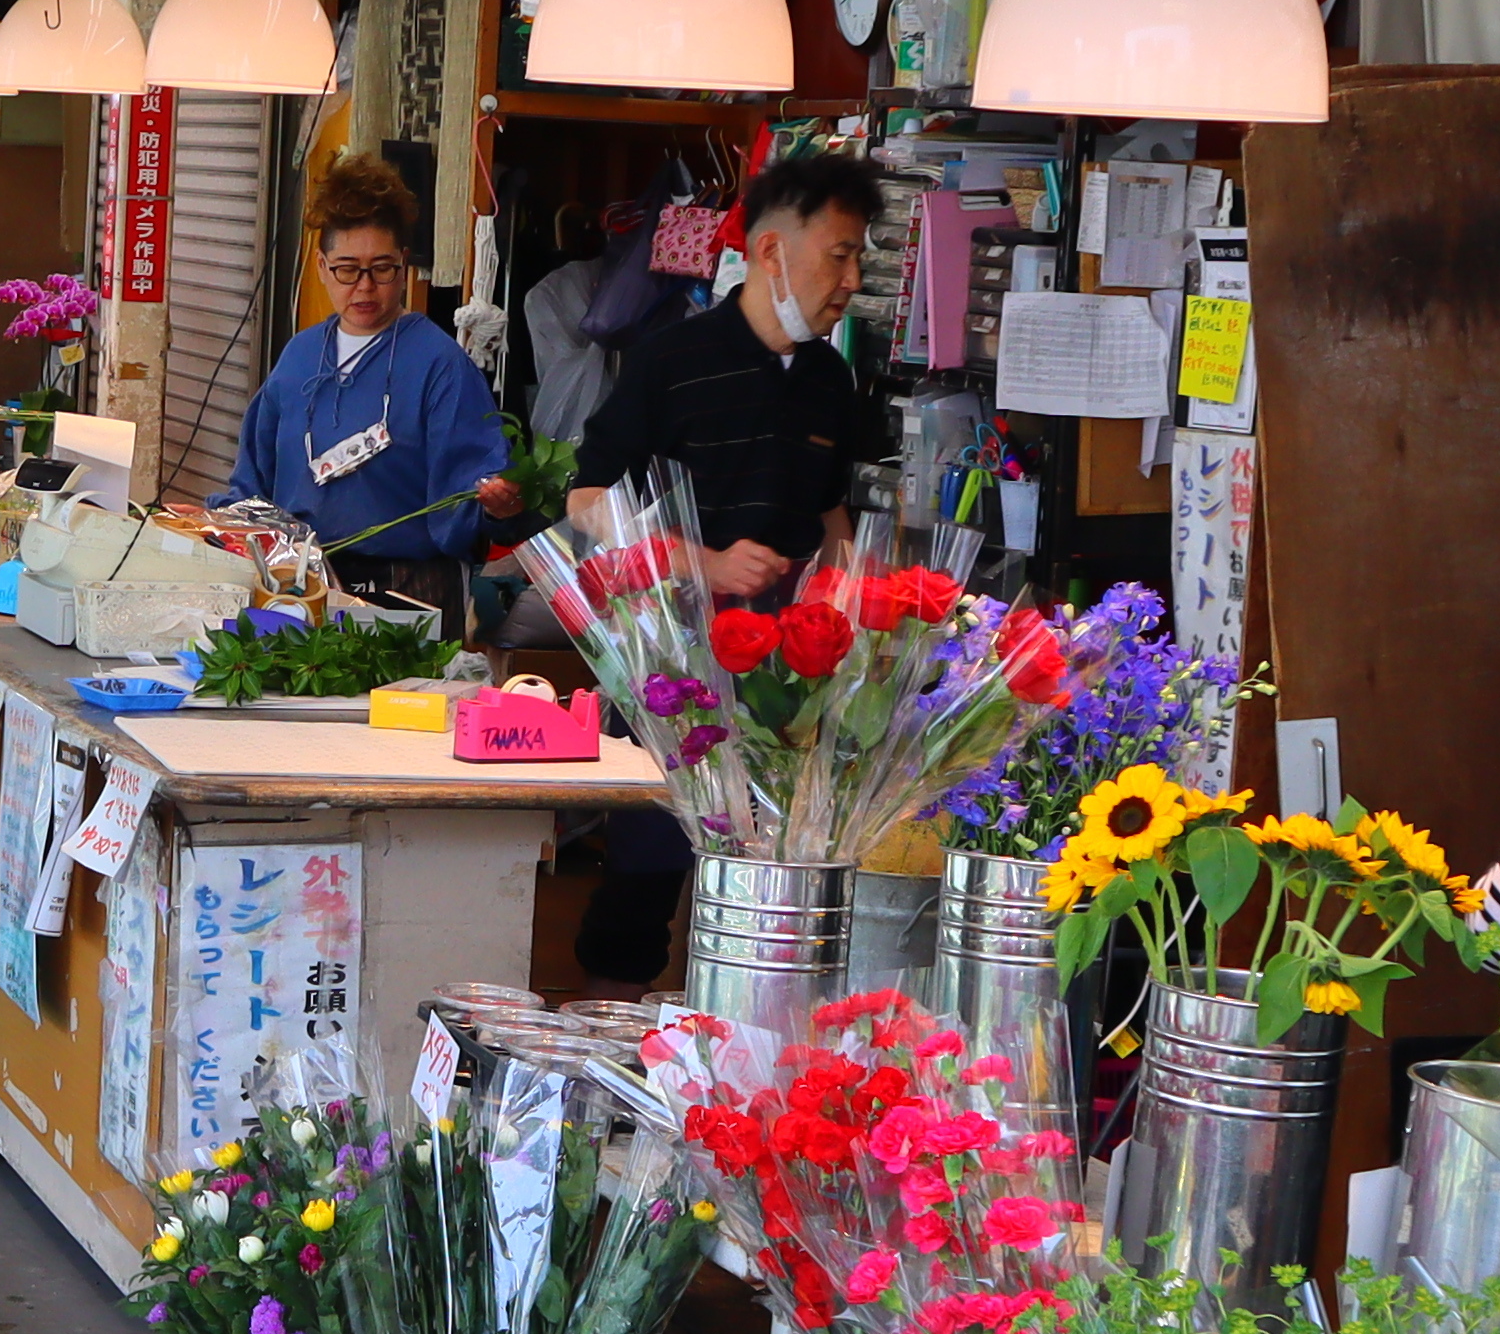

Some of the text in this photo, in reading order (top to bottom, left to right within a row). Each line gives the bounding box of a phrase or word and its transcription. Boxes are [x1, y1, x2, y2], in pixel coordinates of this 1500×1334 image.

[1198, 444, 1226, 611] レシート
[481, 725, 547, 752] TANAKA
[104, 798, 139, 831] できませ
[193, 884, 223, 997] もらって
[231, 858, 286, 1032] レシート
[423, 1023, 457, 1085] メダカ
